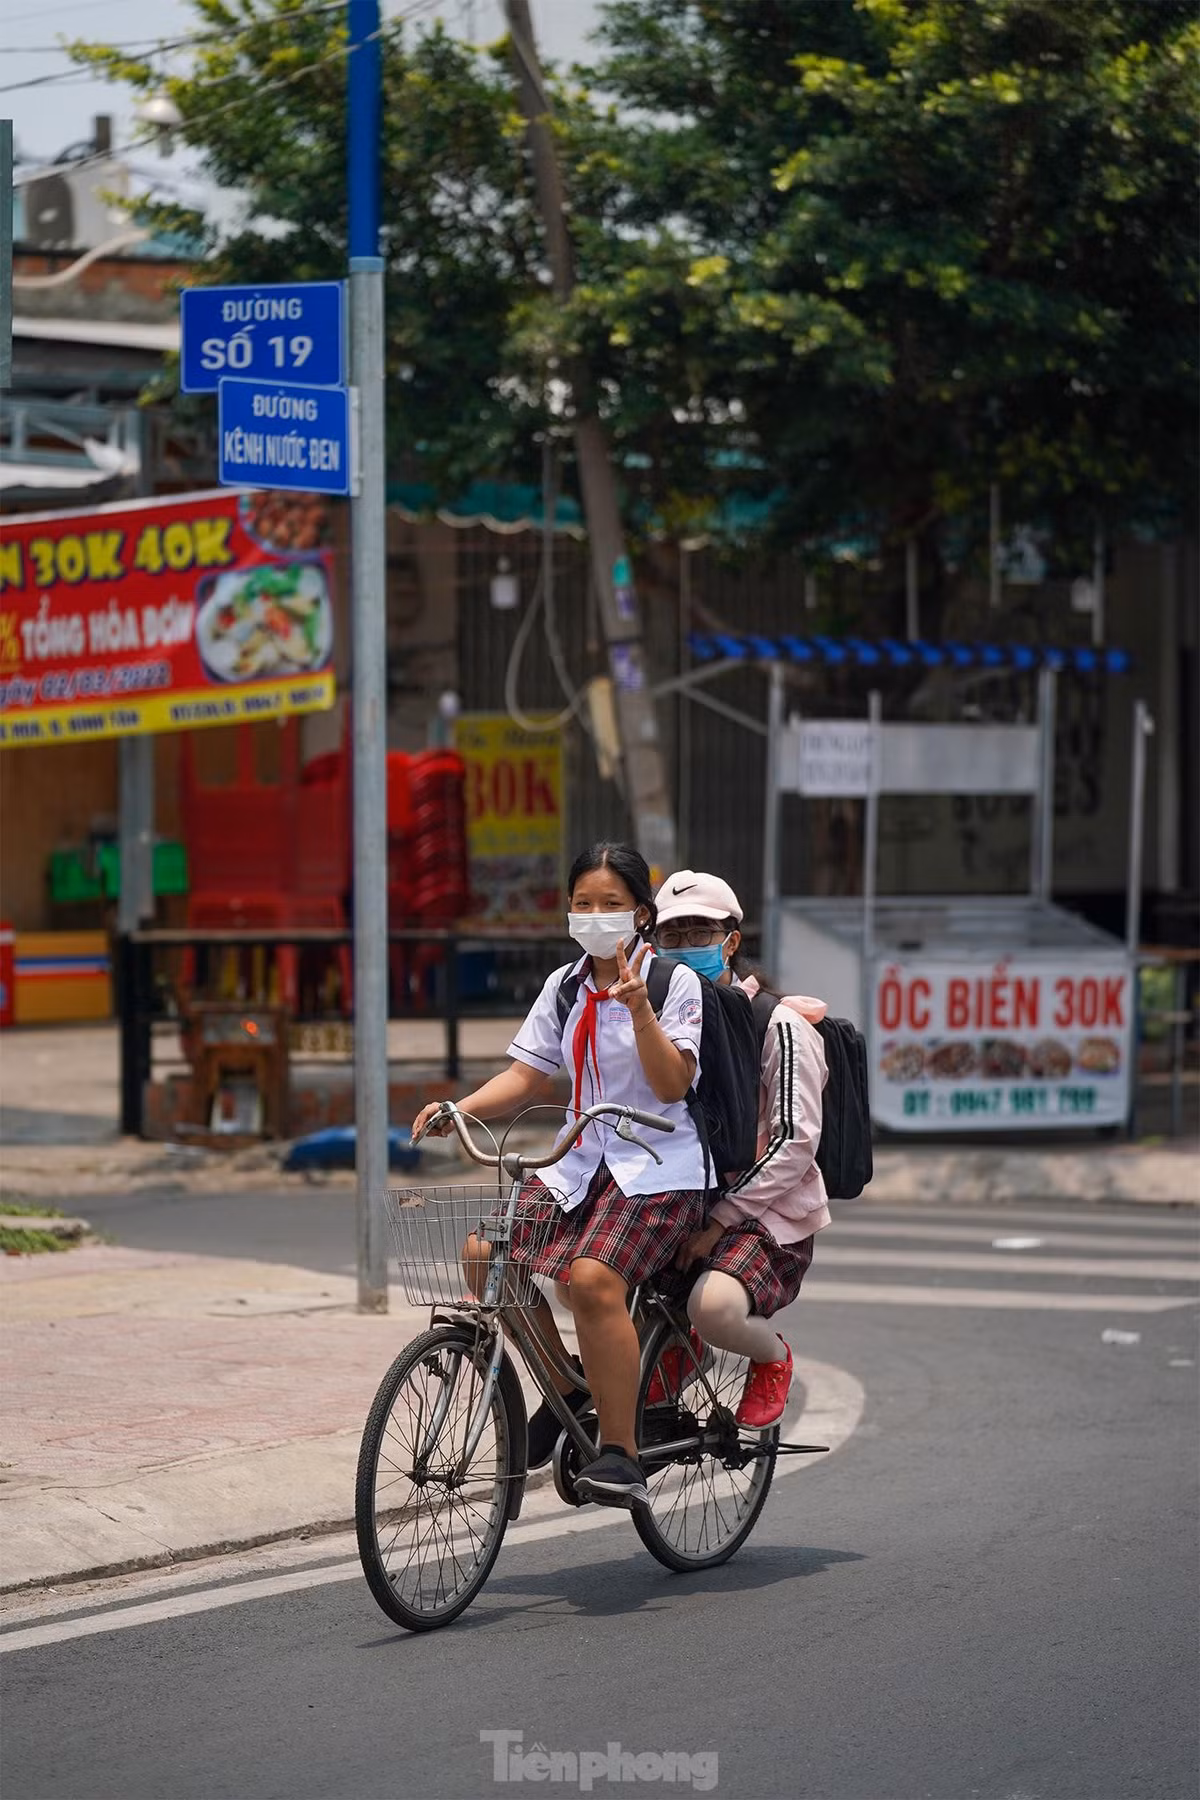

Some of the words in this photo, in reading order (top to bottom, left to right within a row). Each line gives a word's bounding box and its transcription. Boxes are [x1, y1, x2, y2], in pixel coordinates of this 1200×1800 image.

[221, 293, 302, 322] ĐƯỜNG
[200, 325, 256, 370] SỐ
[268, 336, 313, 368] 19
[252, 389, 318, 421] ĐƯỜNG
[224, 426, 264, 466] KÊNH
[266, 430, 307, 469] NƯỚC
[30, 531, 125, 587] 30K
[134, 518, 235, 573] 40K
[21, 595, 84, 660] TỔNG
[1054, 976, 1126, 1028] 30K
